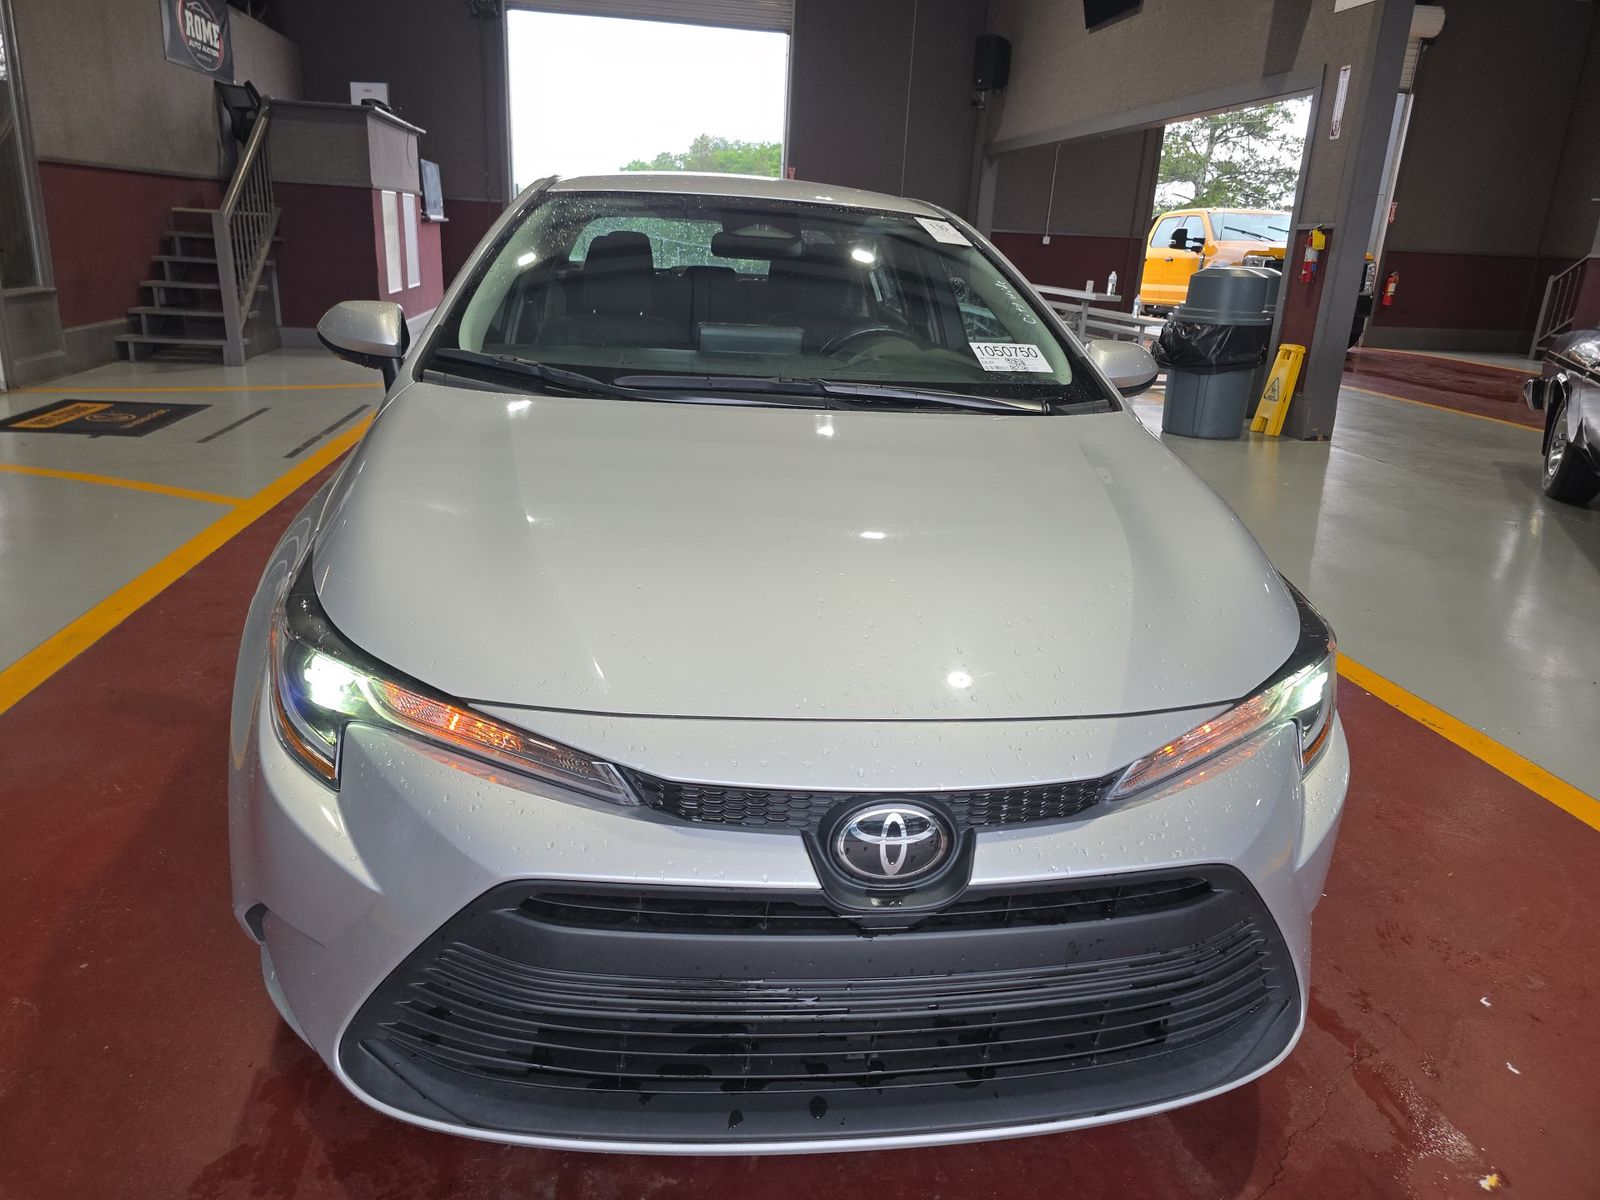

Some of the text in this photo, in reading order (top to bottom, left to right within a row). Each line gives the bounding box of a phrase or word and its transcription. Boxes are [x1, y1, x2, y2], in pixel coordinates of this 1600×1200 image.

[185, 9, 220, 49] ROME
[189, 40, 202, 50] AUTO
[202, 45, 220, 58] AUCTION
[976, 345, 1038, 358] 1050750
